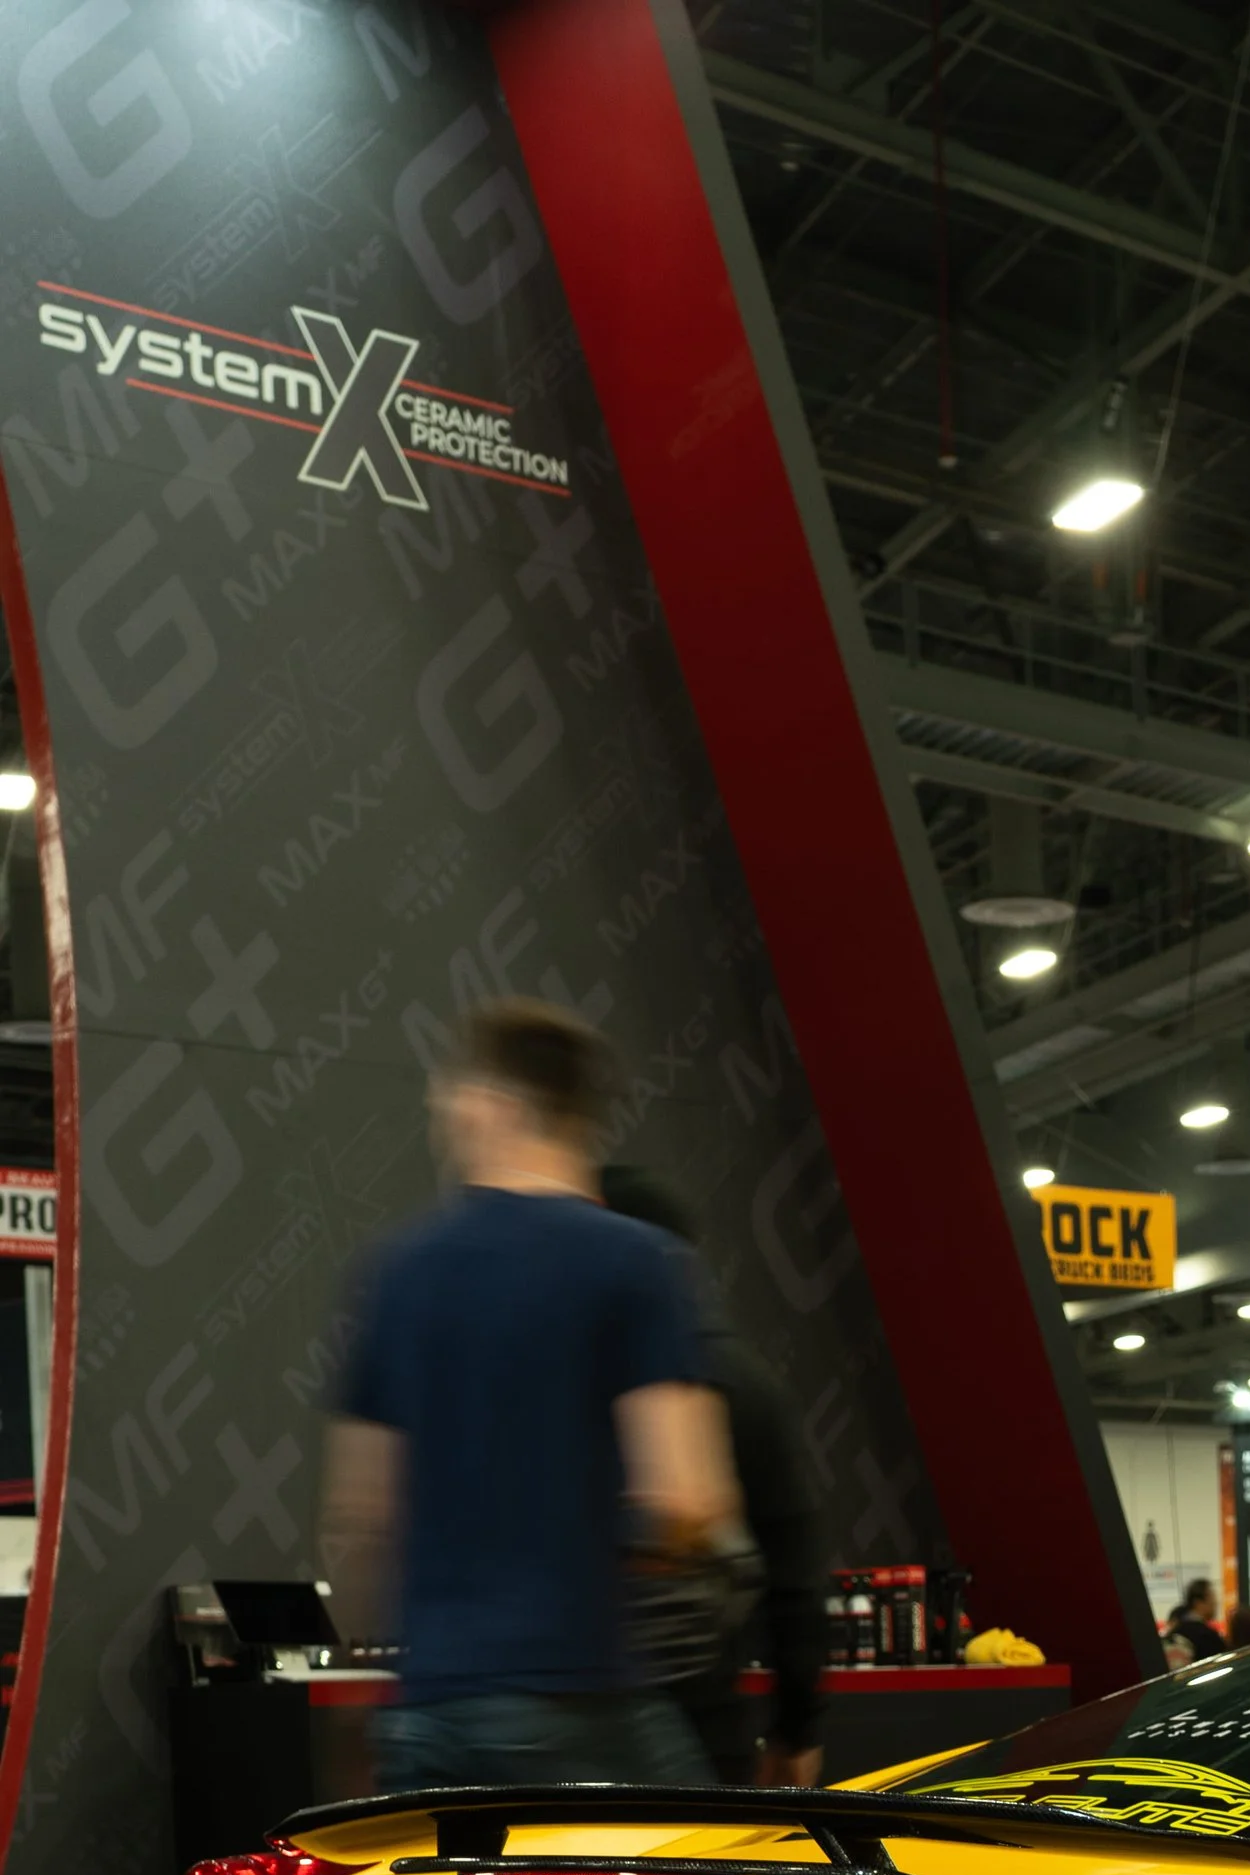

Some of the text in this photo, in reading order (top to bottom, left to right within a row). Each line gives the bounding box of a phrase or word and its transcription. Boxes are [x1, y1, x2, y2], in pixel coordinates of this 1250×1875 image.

[395, 392, 512, 445] CERAMIC
[411, 423, 569, 486] PROTECTION
[1051, 1202, 1151, 1260] OCK
